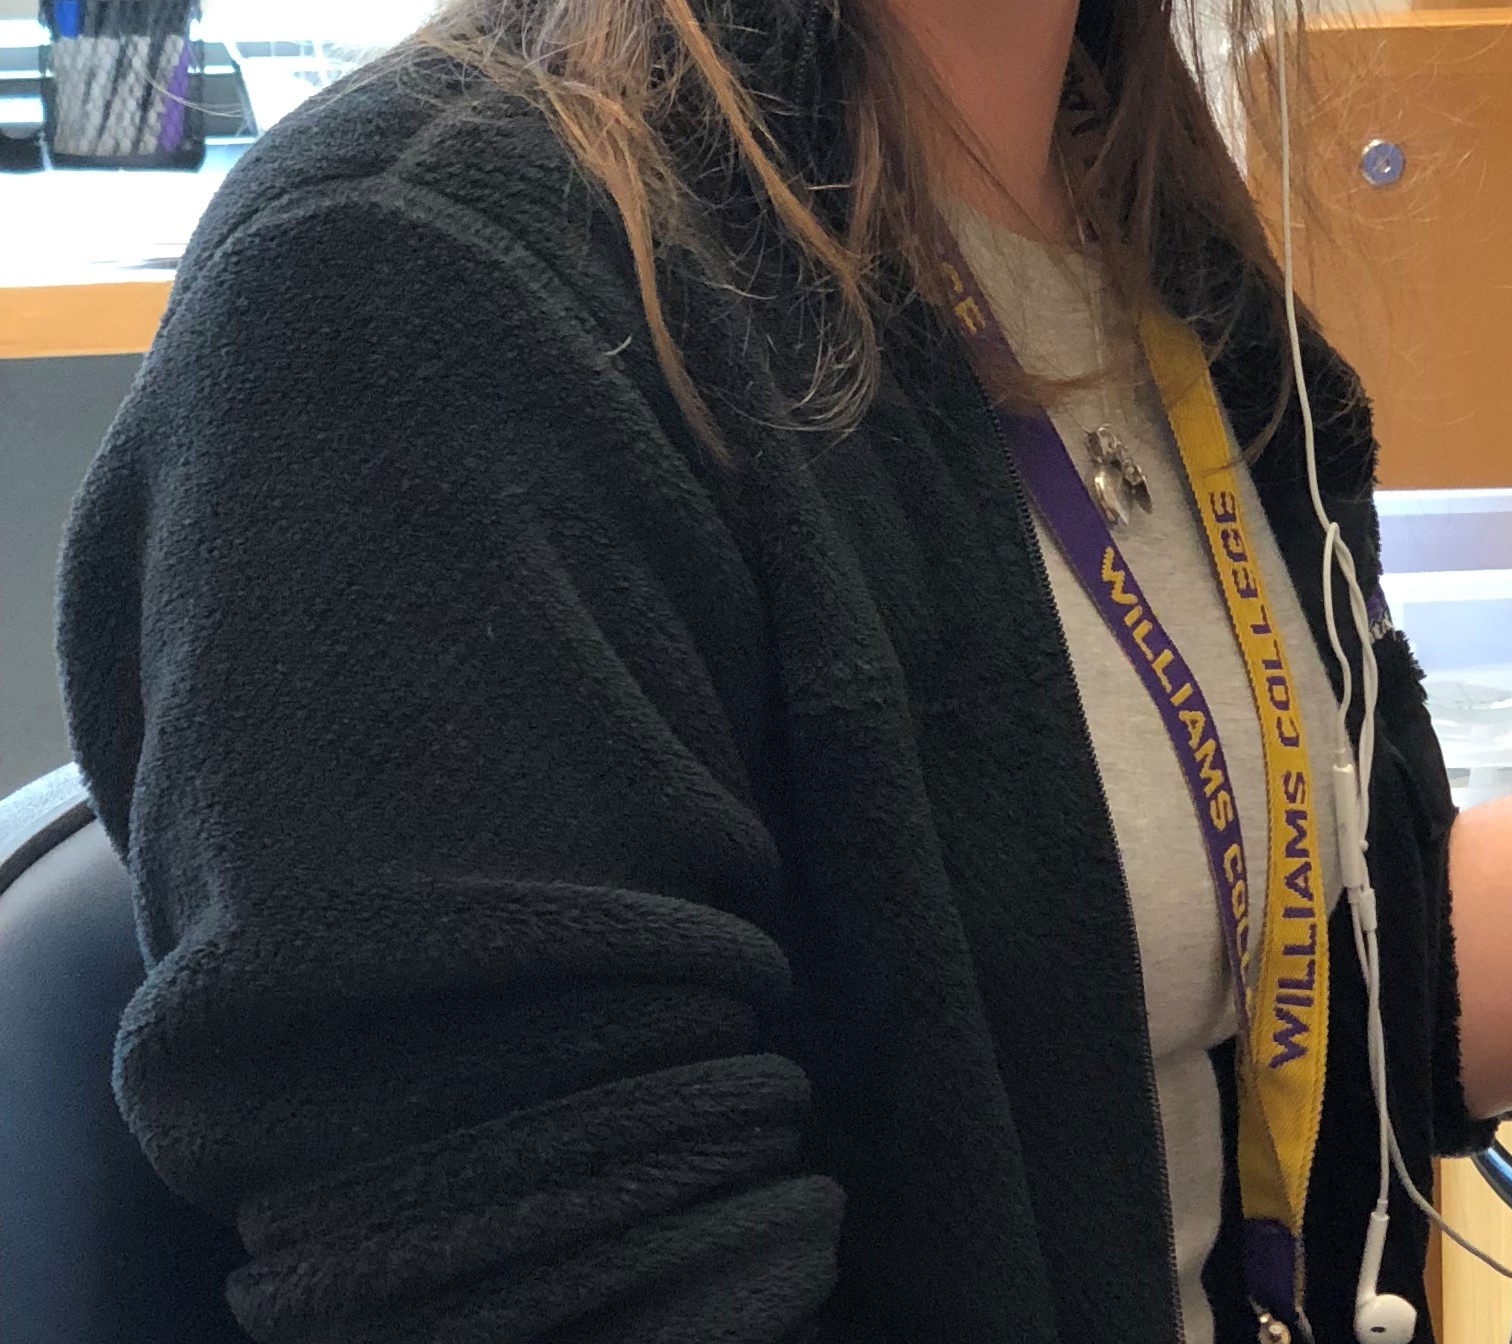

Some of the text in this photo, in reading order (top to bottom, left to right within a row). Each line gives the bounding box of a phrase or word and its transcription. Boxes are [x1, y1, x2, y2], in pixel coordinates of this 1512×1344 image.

[1101, 545, 1237, 833] WILLIAMS
[1208, 490, 1318, 1071] WILLIAMS COLLEGE
